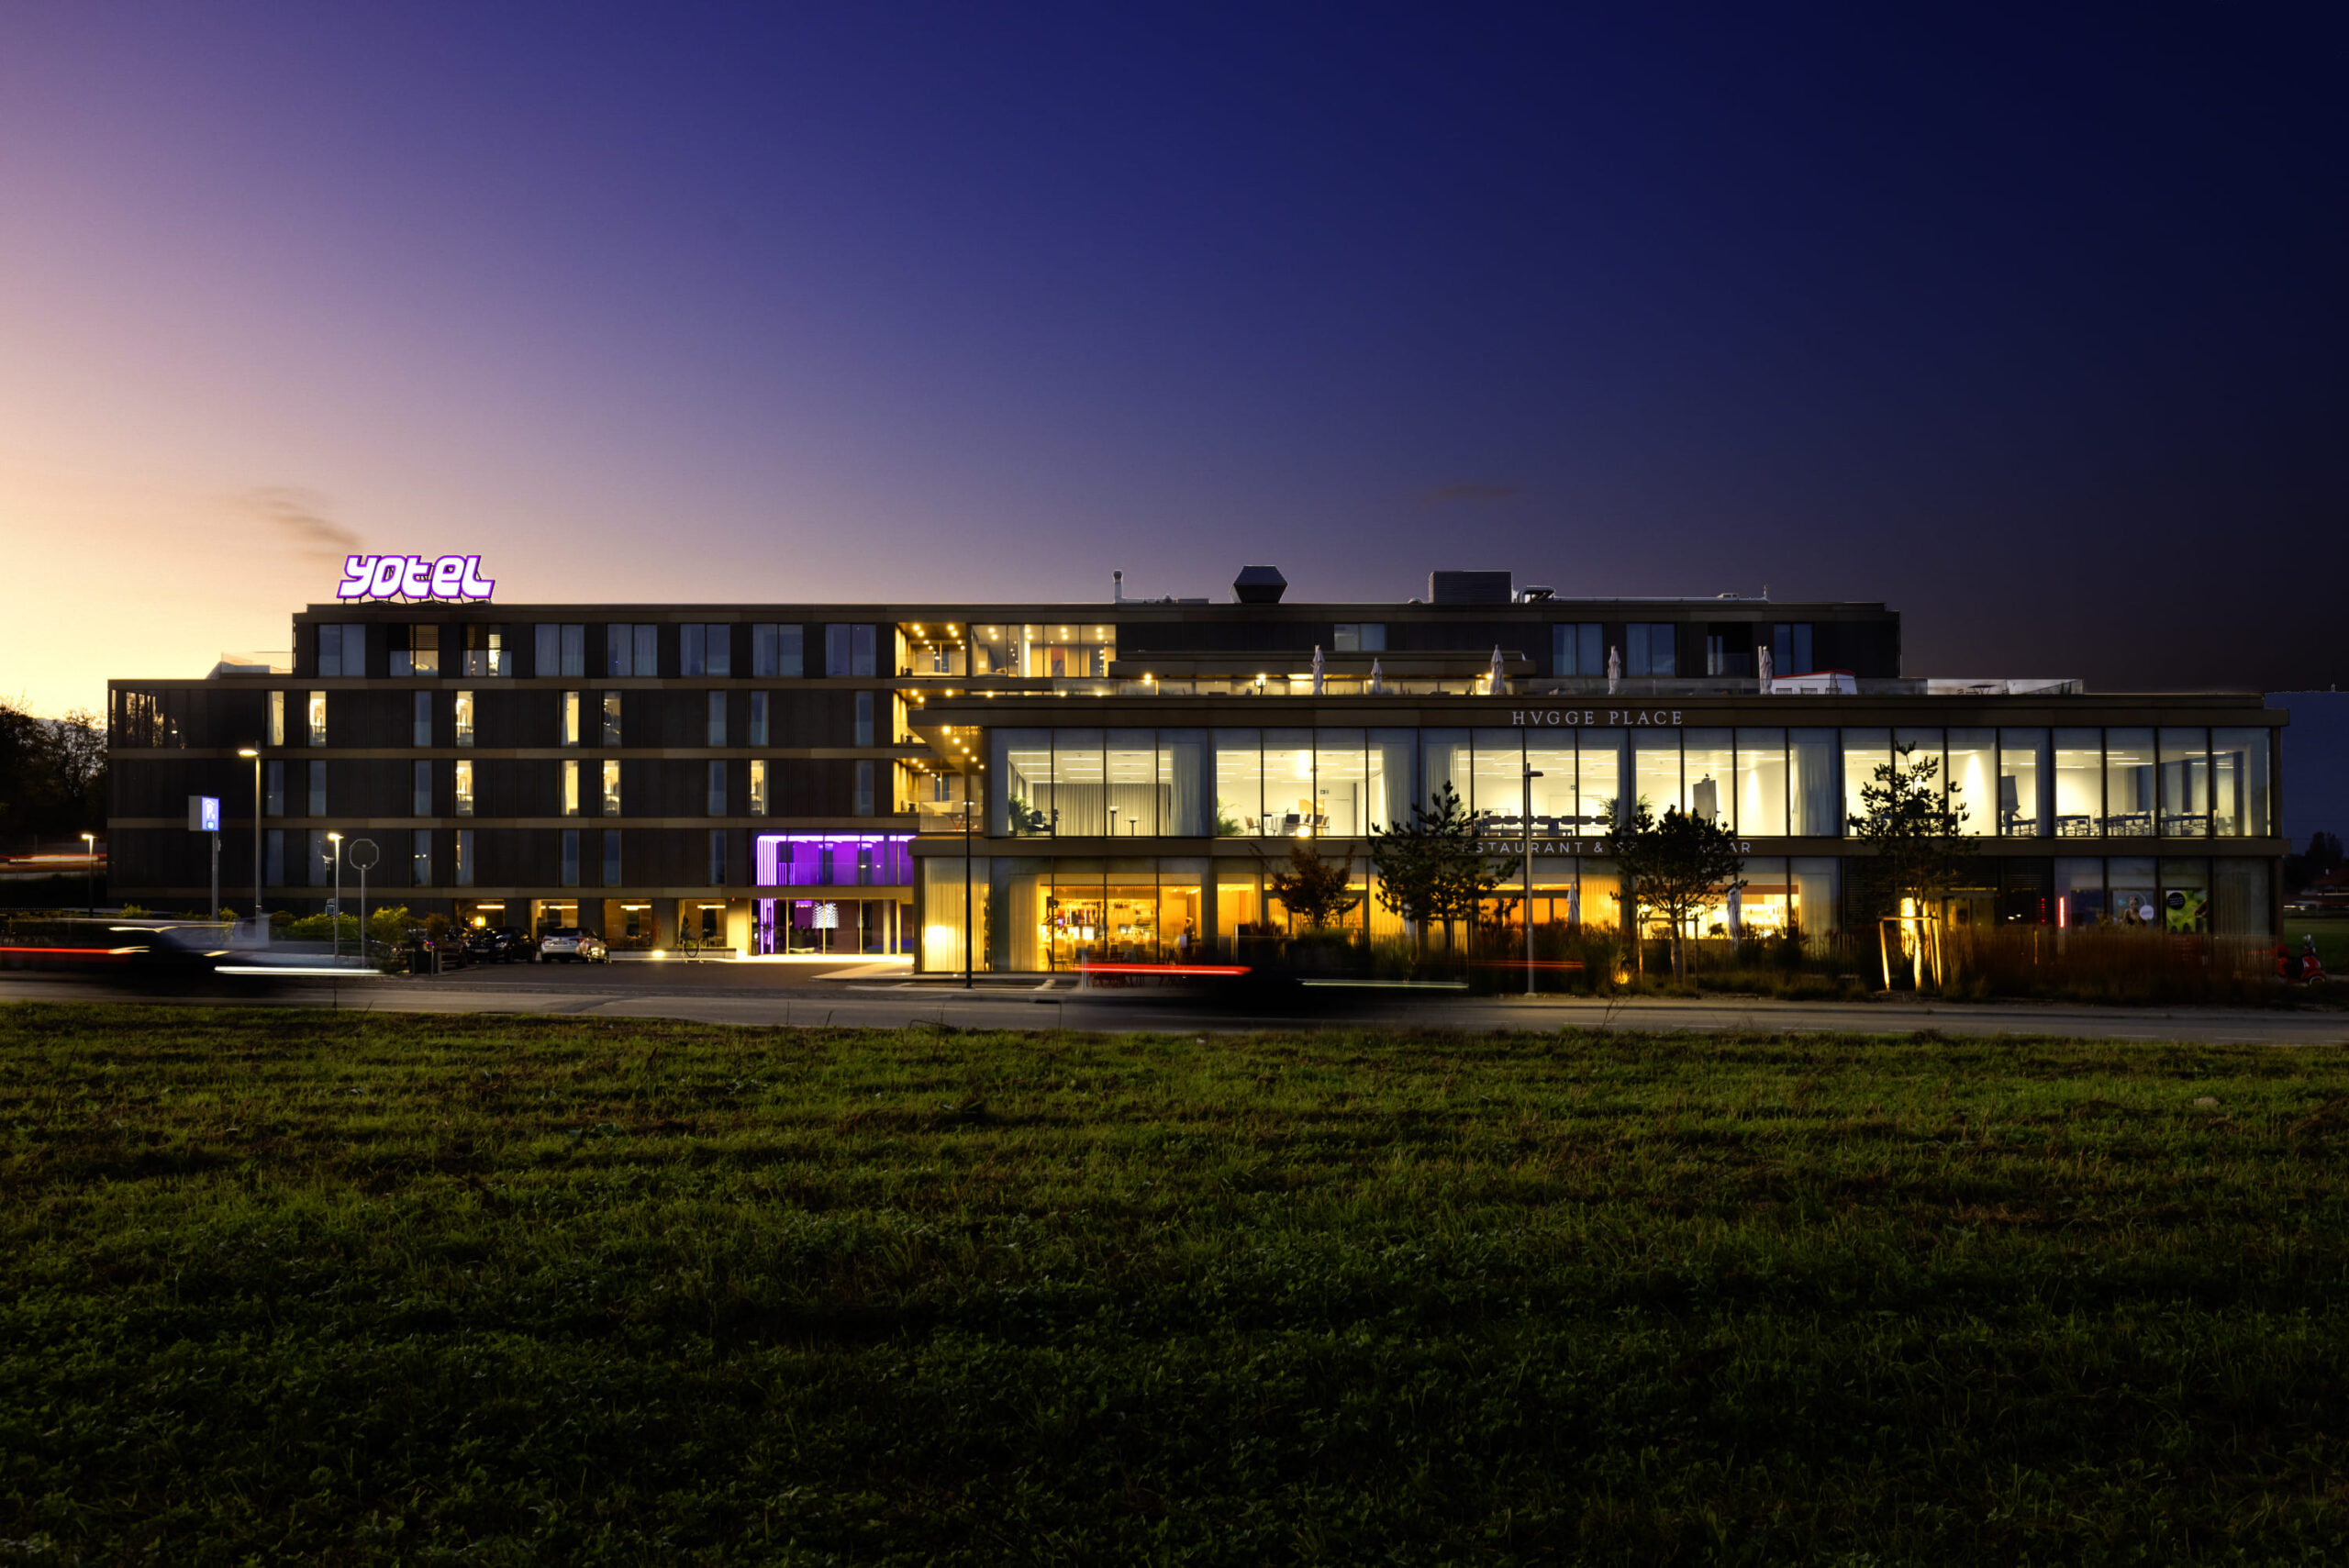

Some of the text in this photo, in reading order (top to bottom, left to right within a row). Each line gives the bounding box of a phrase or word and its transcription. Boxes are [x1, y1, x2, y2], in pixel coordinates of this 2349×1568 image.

[1609, 711, 1682, 725] PLACE
[1447, 841, 1583, 853] STAURANT
[1593, 841, 1604, 853] &
